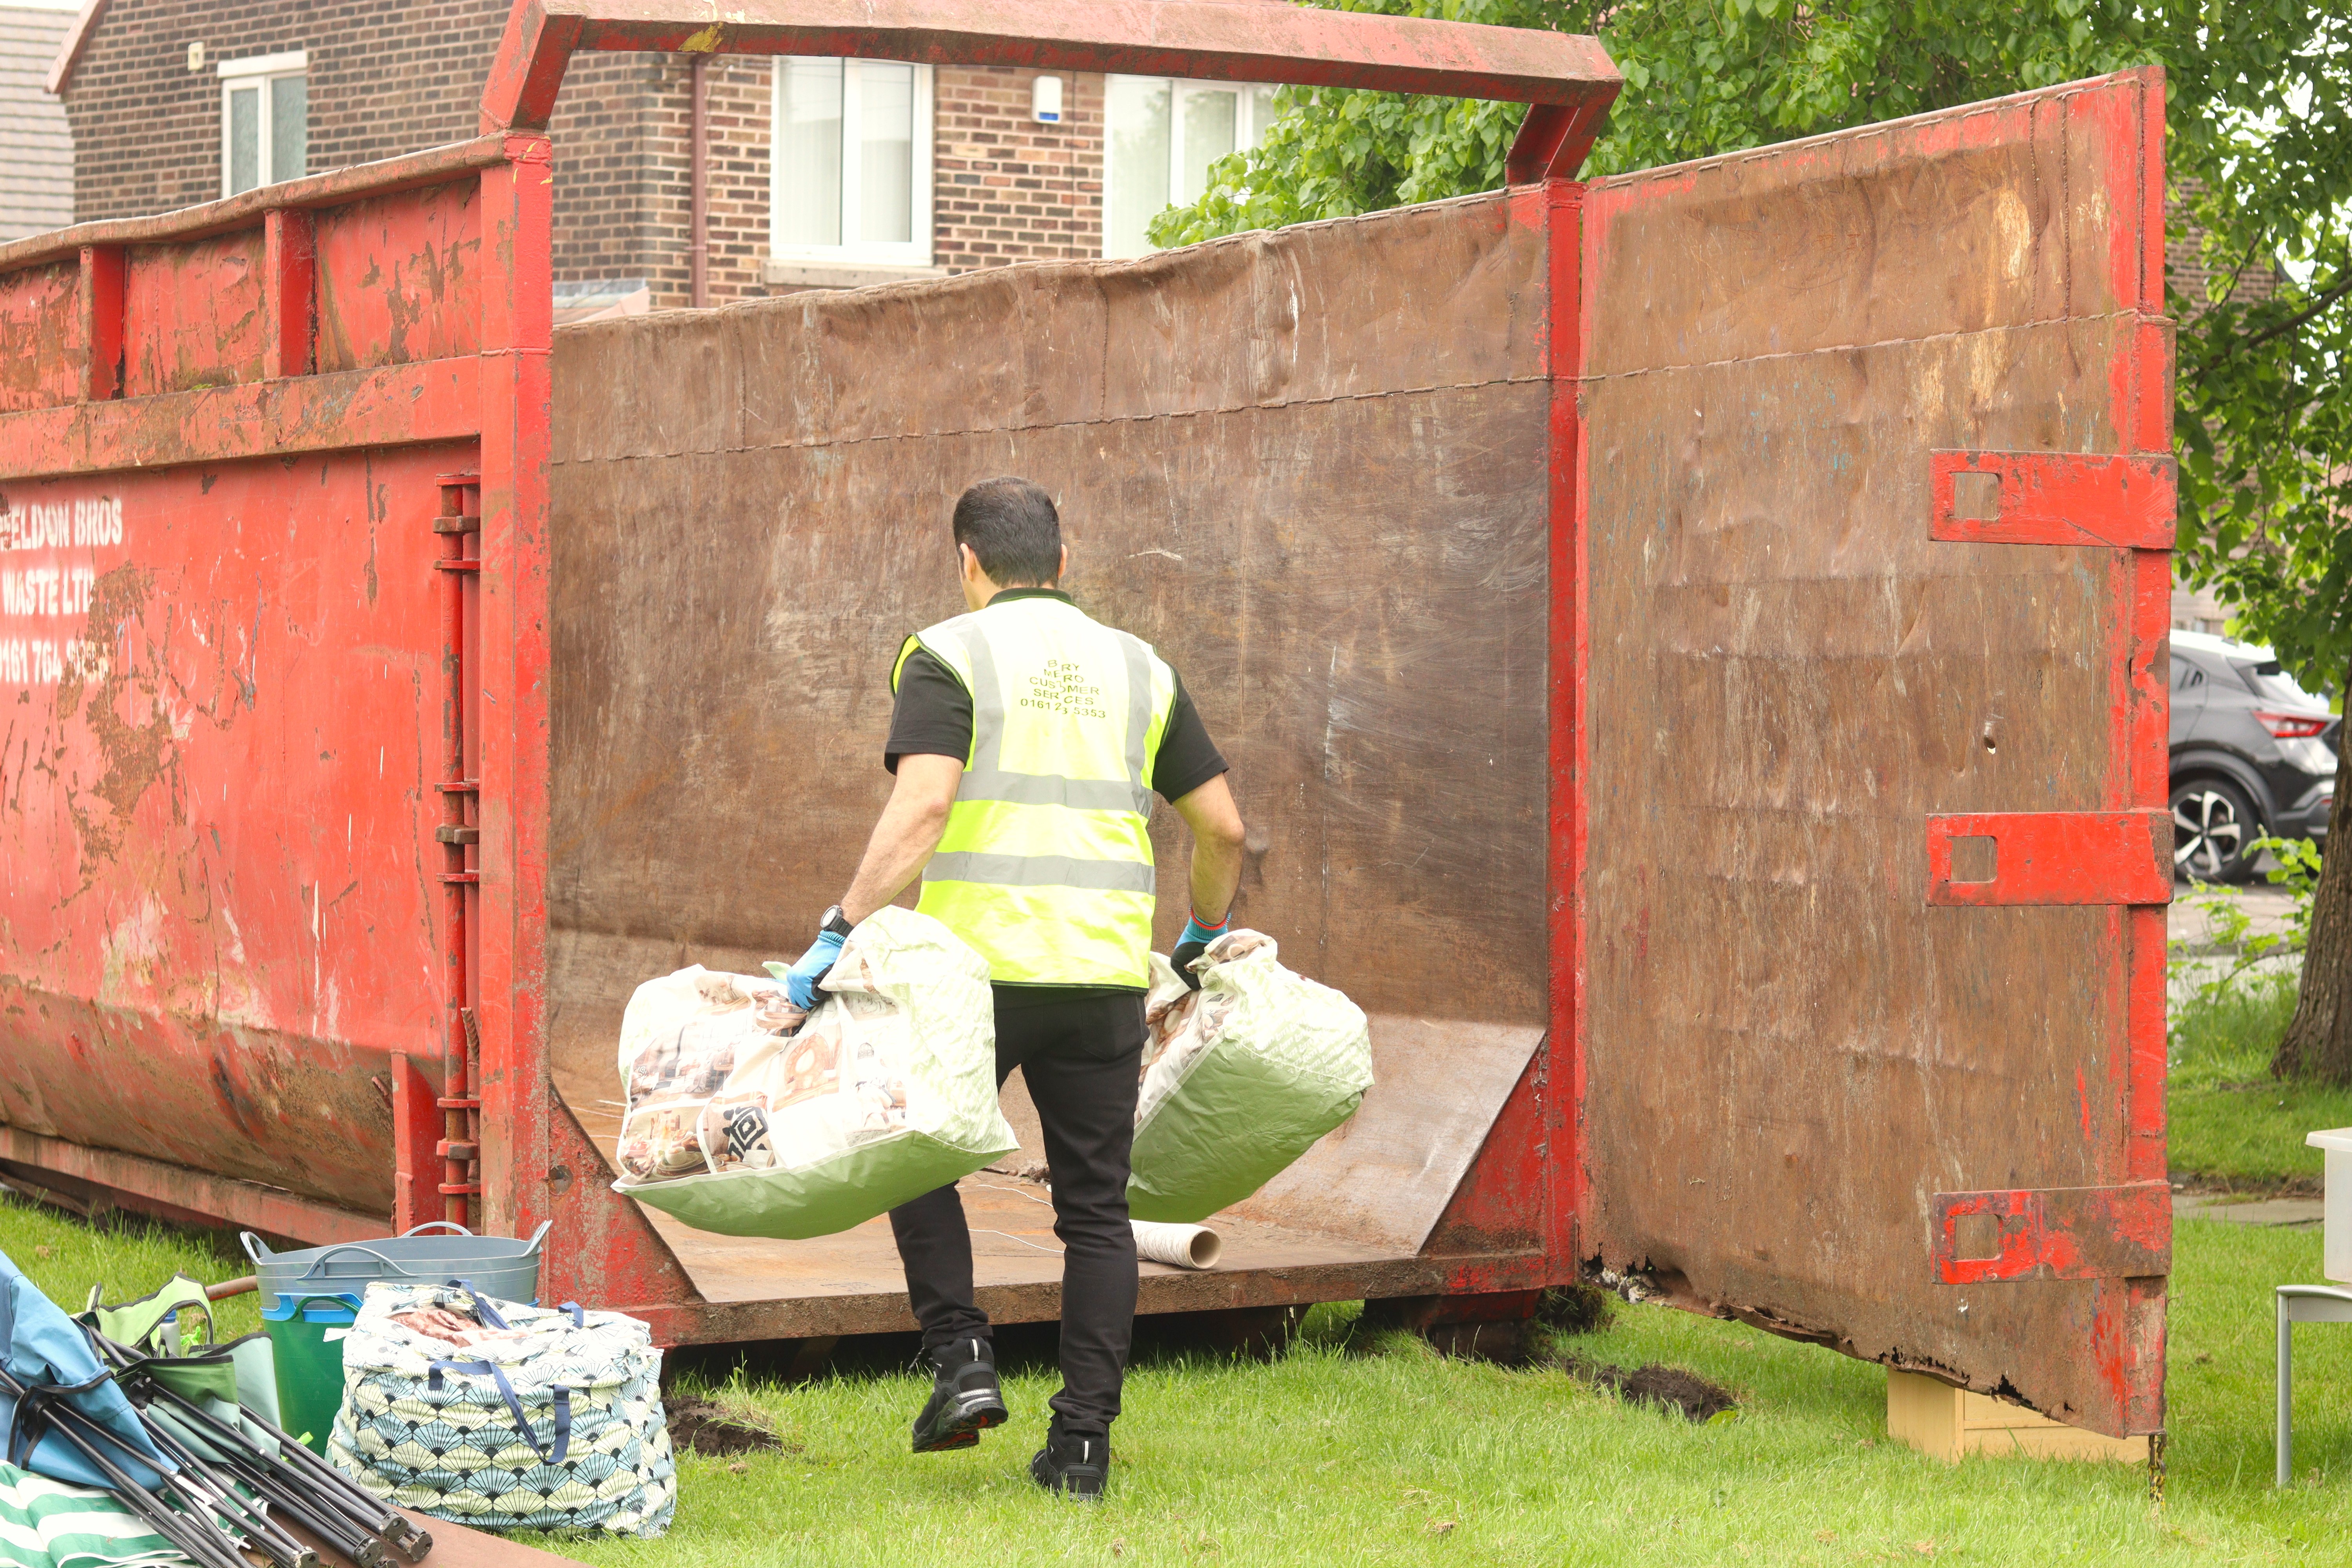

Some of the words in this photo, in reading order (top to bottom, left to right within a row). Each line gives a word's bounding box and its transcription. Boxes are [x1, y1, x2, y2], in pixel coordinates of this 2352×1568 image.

[74, 498, 122, 545] BROS
[3, 568, 59, 615] WASTE
[62, 568, 95, 614] LTD
[0, 639, 28, 683] 161
[32, 640, 62, 683] 764
[1048, 660, 1079, 671] BRY
[1044, 669, 1083, 682] MERO
[1033, 689, 1093, 704] SERCES
[1020, 699, 1050, 709] 0161
[1074, 707, 1105, 718] 5353
